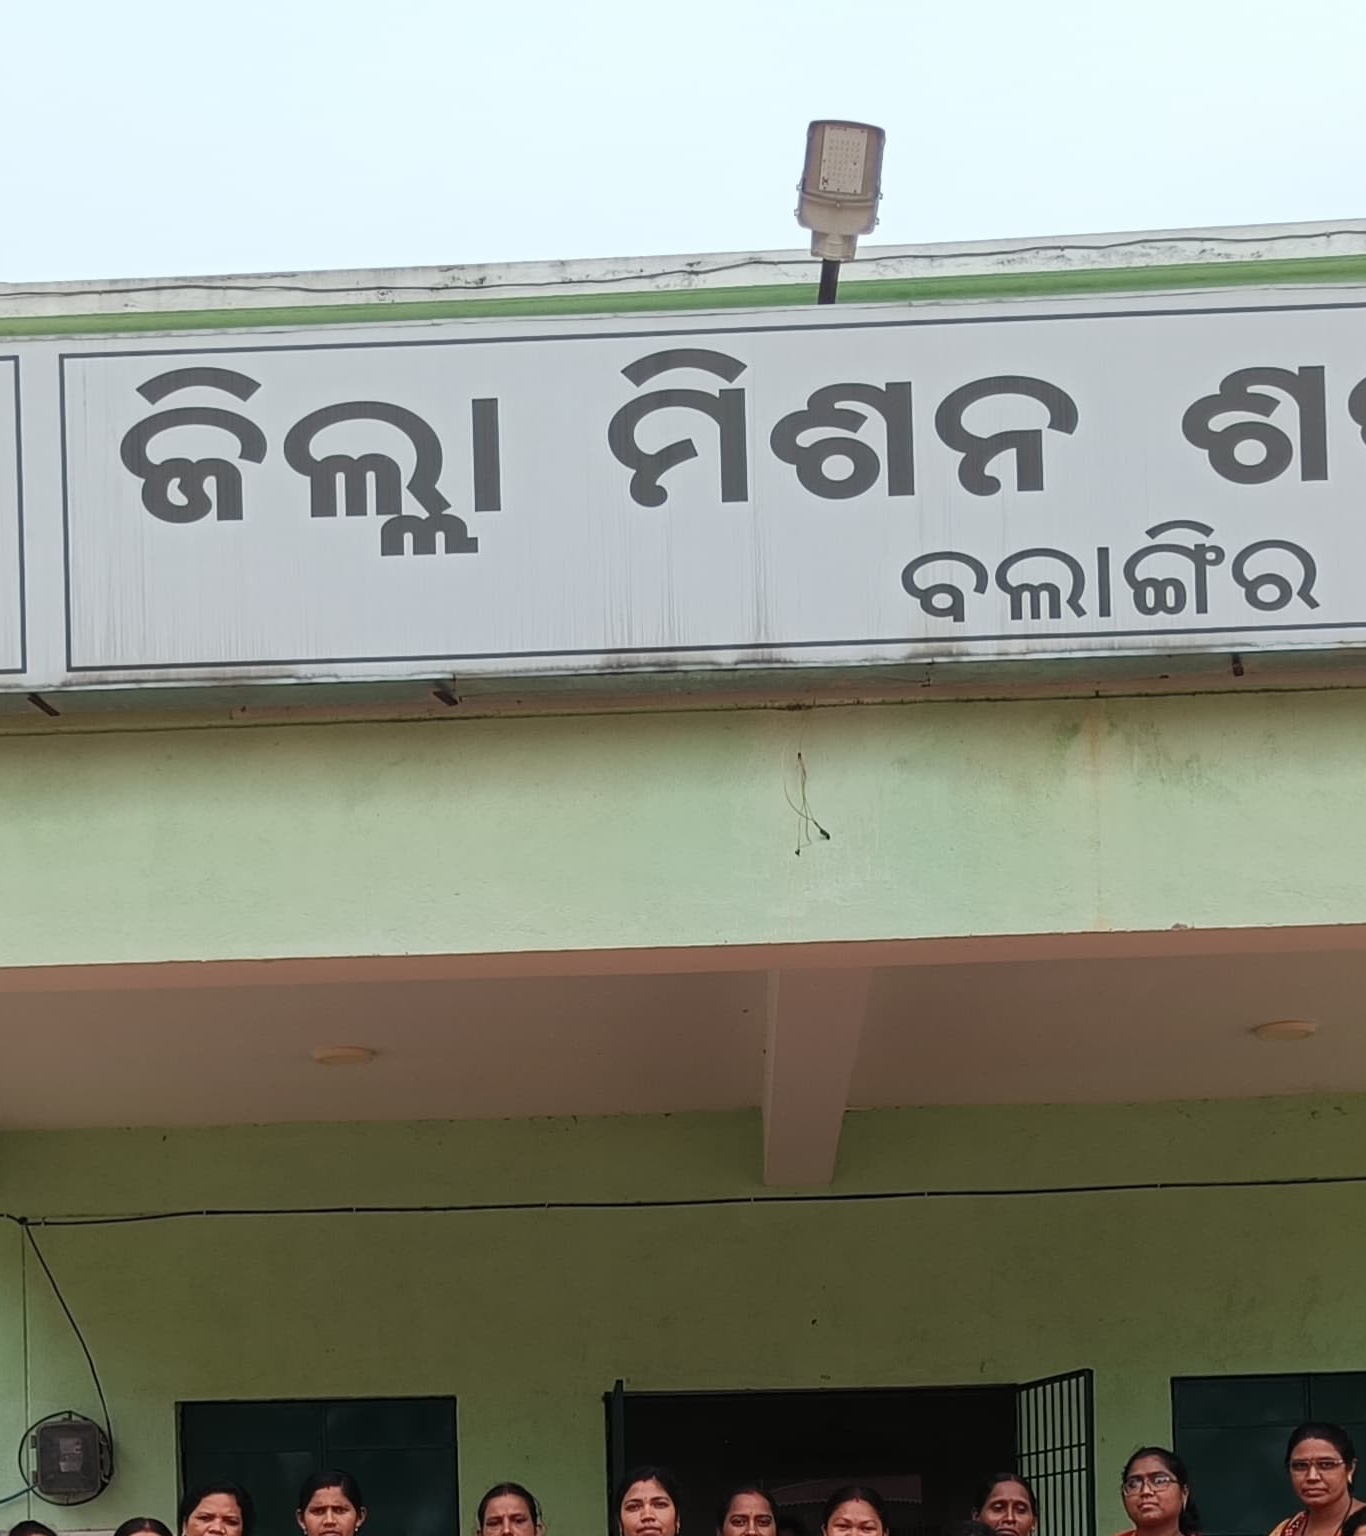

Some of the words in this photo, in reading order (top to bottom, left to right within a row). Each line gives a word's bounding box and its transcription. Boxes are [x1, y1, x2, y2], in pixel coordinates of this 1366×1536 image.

[120, 366, 502, 557] ଜିଲ୍ଲା
[607, 348, 1079, 509] ମିଶନ
[901, 519, 1321, 623] ବଲାଙ୍ଗିର
